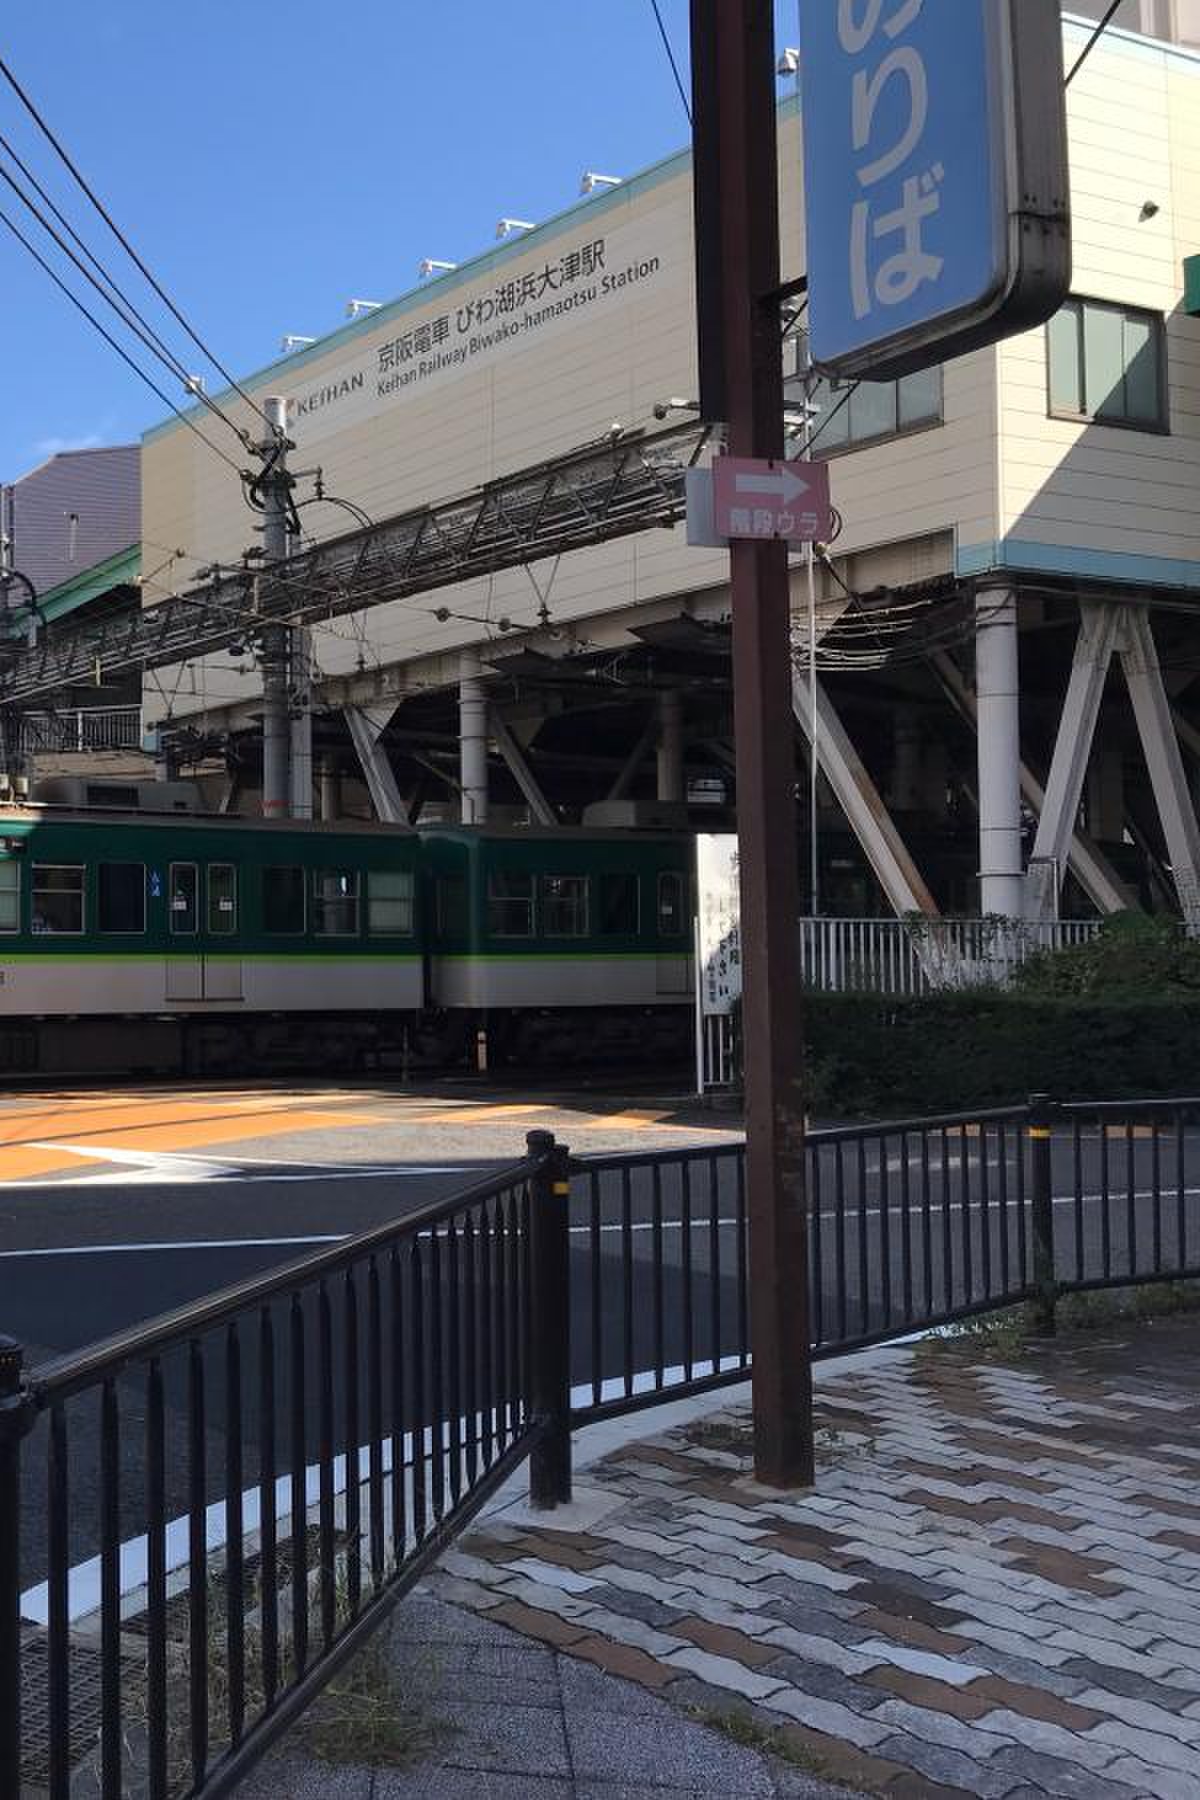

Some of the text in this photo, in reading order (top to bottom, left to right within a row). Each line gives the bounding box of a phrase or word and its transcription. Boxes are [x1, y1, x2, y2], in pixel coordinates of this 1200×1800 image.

[377, 239, 606, 373] 京阪電車 びわ湖浜大津駅
[377, 256, 660, 397] Keihan Railway Biwako-hamaotsu Station
[297, 372, 364, 415] KEIHAN
